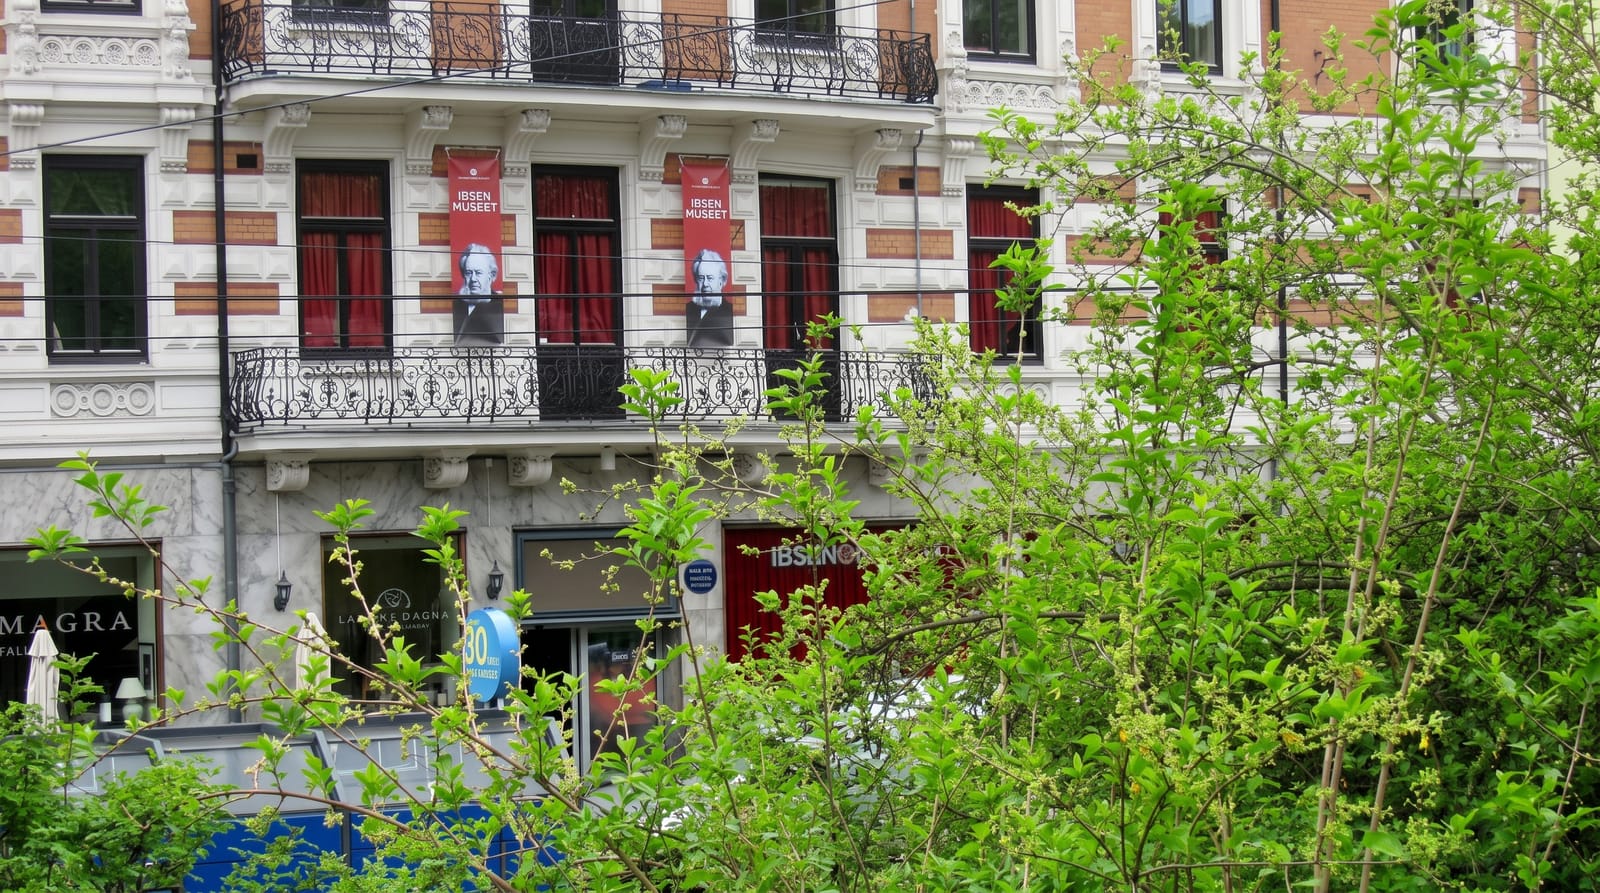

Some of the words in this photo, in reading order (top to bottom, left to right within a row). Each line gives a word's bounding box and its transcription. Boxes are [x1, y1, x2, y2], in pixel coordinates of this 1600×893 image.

[458, 191, 491, 201] IBSEN
[452, 202, 498, 212] MUSEET
[691, 198, 722, 209] IBSEN
[685, 209, 728, 219] MUSEET
[402, 611, 449, 620] DAGNA
[0, 611, 133, 635] MAGRA
[465, 625, 488, 665] 30
